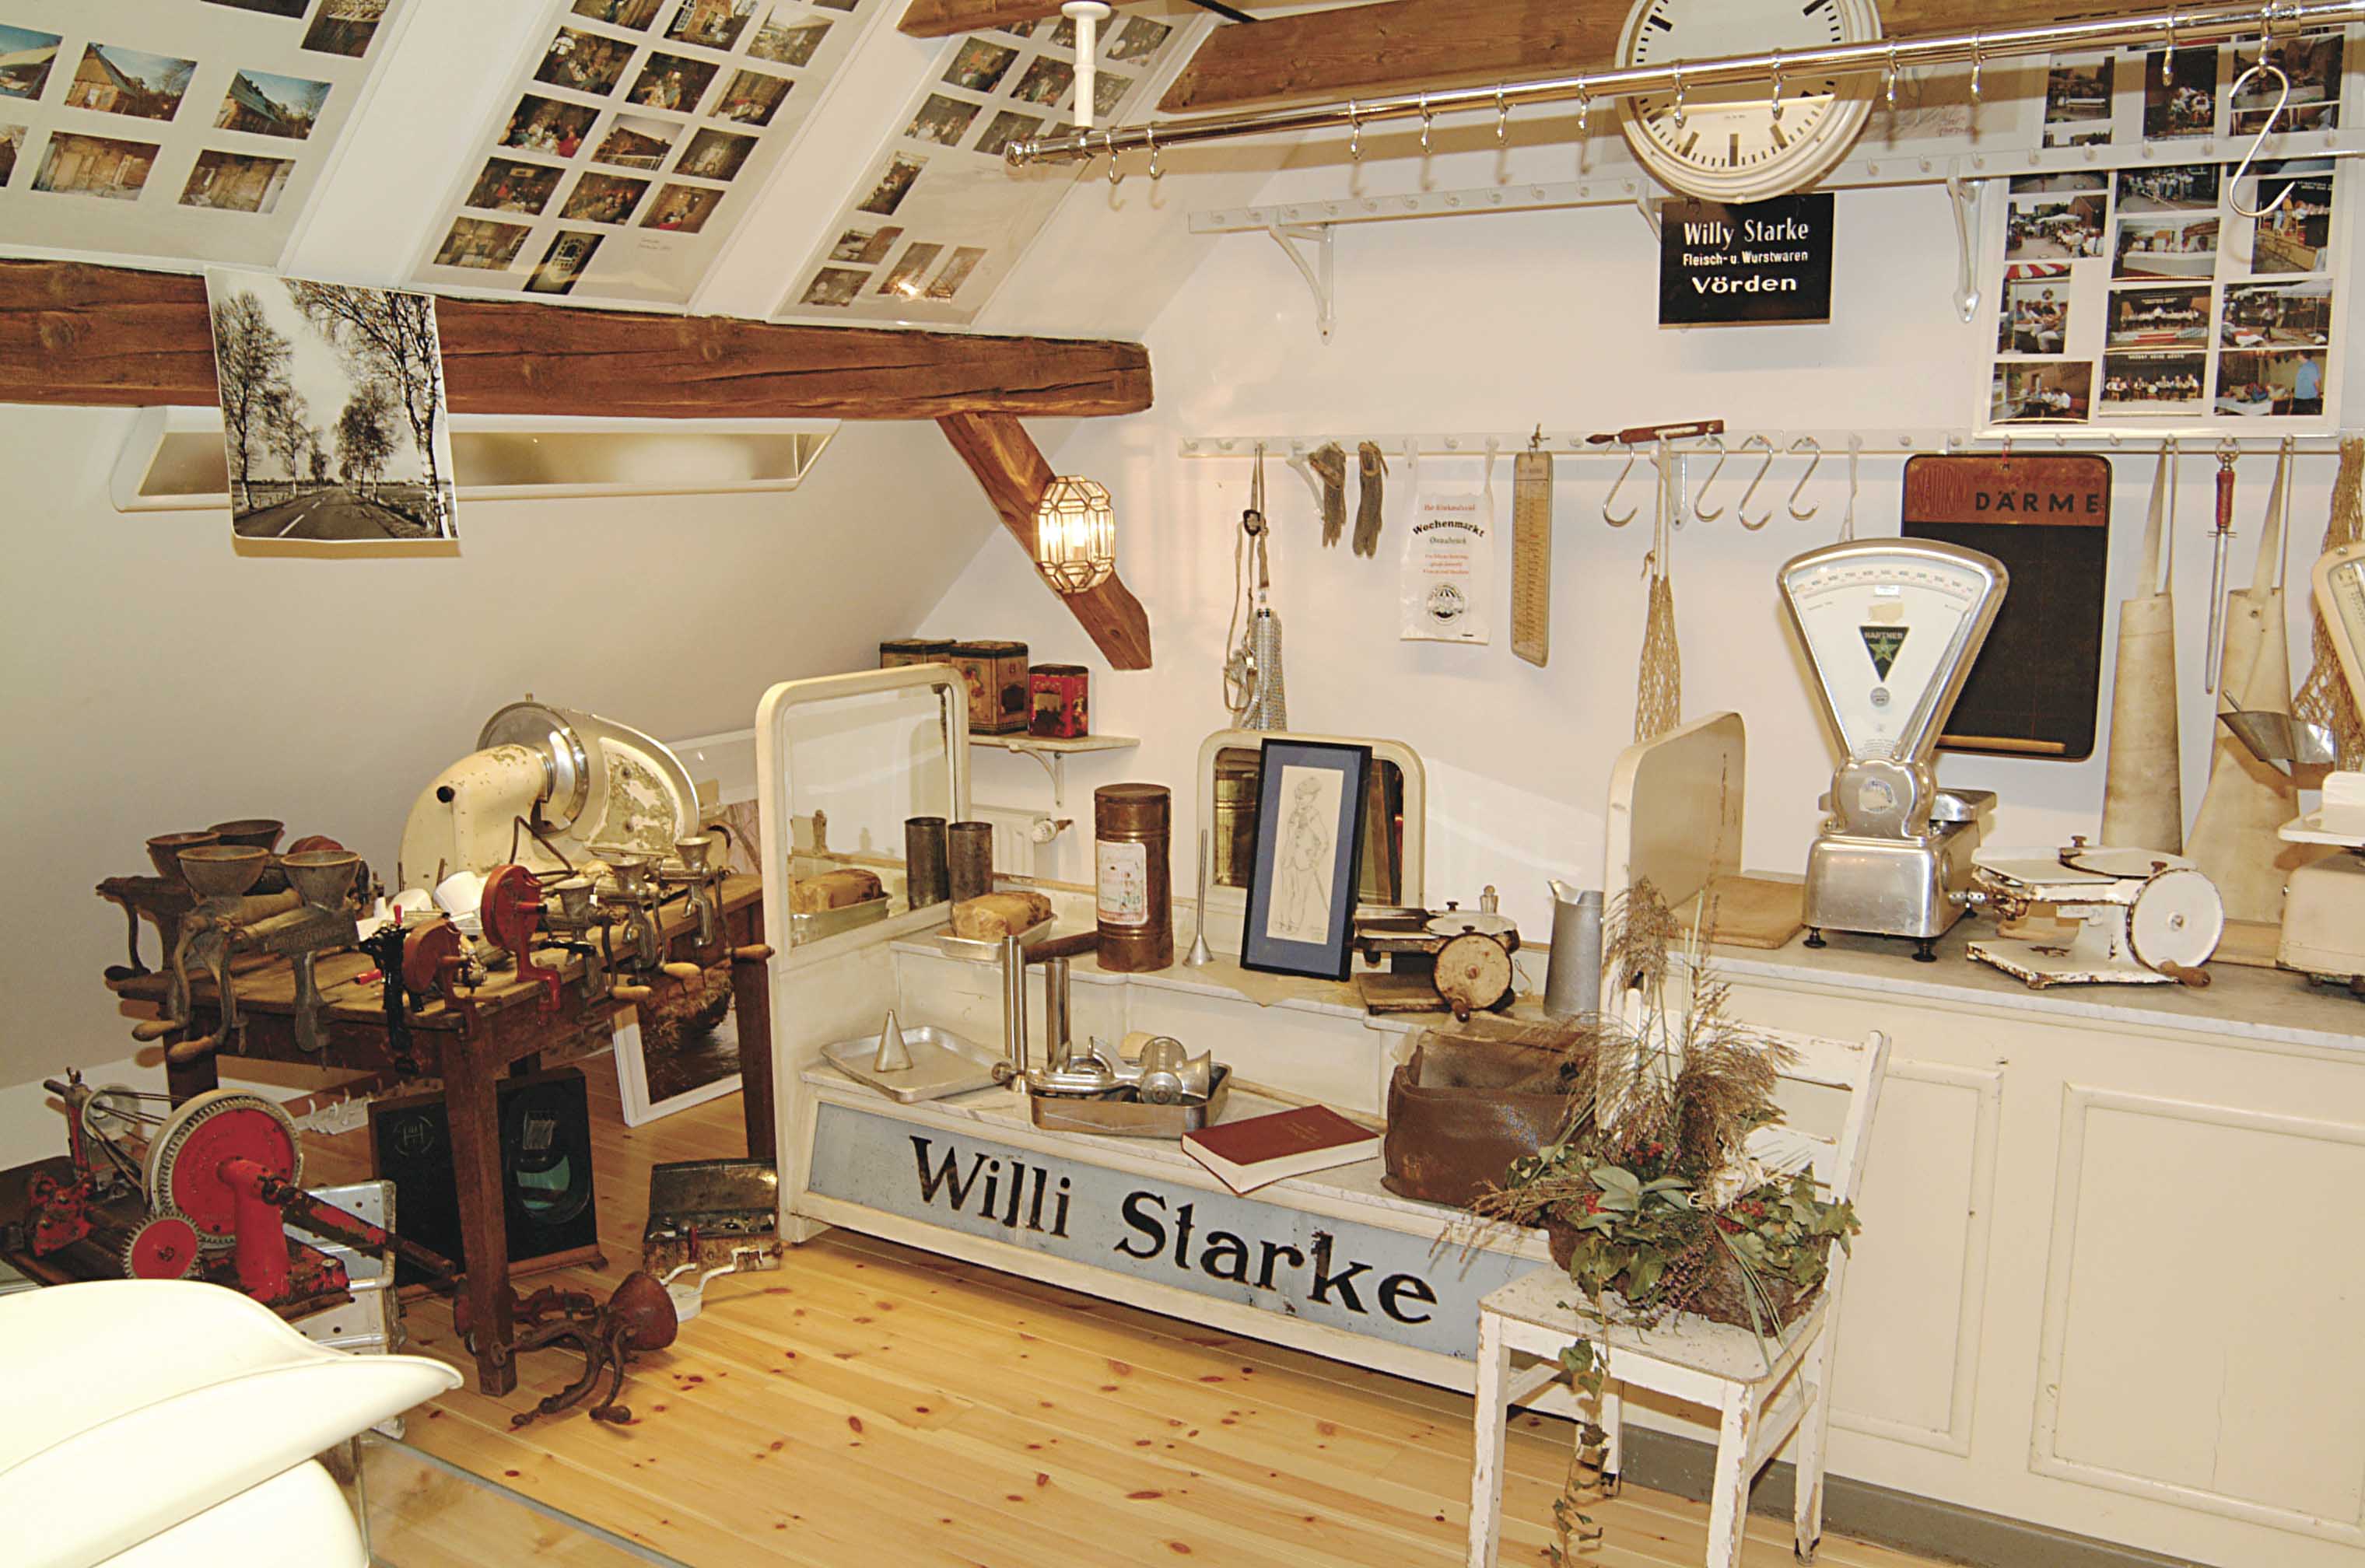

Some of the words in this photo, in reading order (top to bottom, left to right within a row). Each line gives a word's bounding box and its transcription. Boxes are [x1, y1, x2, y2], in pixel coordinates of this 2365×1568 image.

[1684, 221, 1734, 250] Willy
[1744, 217, 1809, 243] Starke
[1683, 254, 1728, 266] Fleisch-
[1730, 255, 1740, 264] u.
[1742, 250, 1808, 263] Wurstwaren
[1692, 275, 1797, 294] Vörden
[1974, 490, 2100, 514] DÄRME
[1413, 520, 1484, 537] Wochenmarkt
[909, 1135, 1071, 1239] Willi
[1113, 1191, 1438, 1324] Starke
